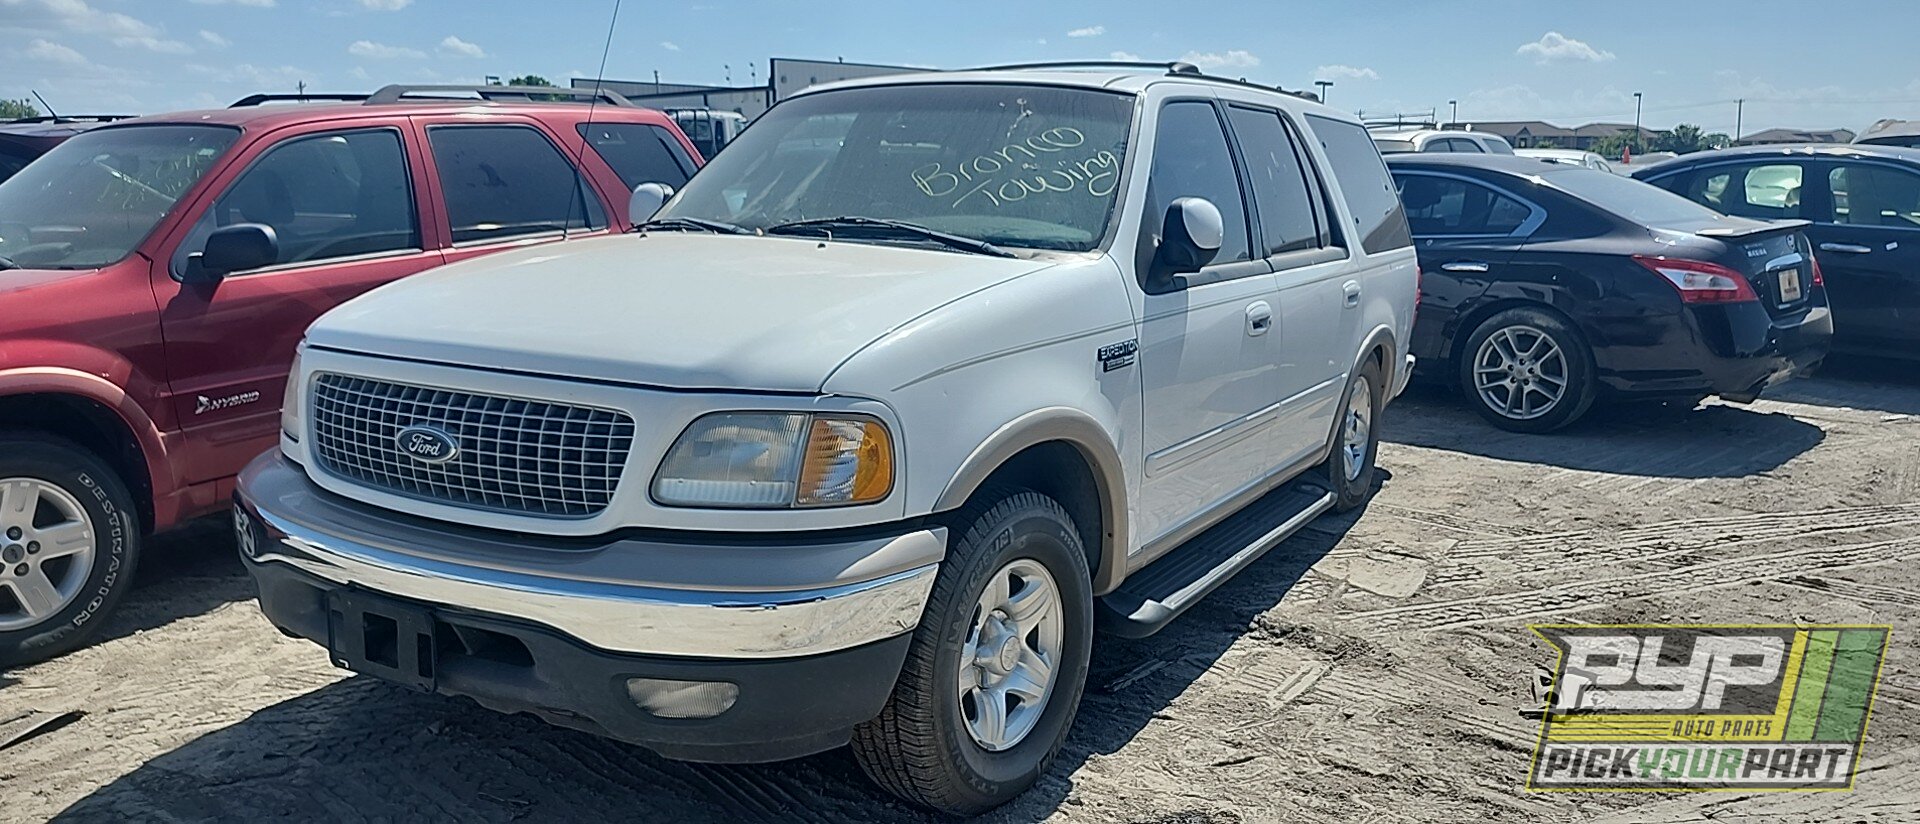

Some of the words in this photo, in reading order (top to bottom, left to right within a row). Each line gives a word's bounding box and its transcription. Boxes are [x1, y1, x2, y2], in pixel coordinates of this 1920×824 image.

[911, 127, 1085, 197] Bronco
[952, 150, 1120, 208] Towing
[1100, 339, 1139, 360] EXPEDITION
[210, 390, 260, 411] HYBRID
[408, 433, 442, 457] Ford
[77, 472, 123, 627] DESTINATION
